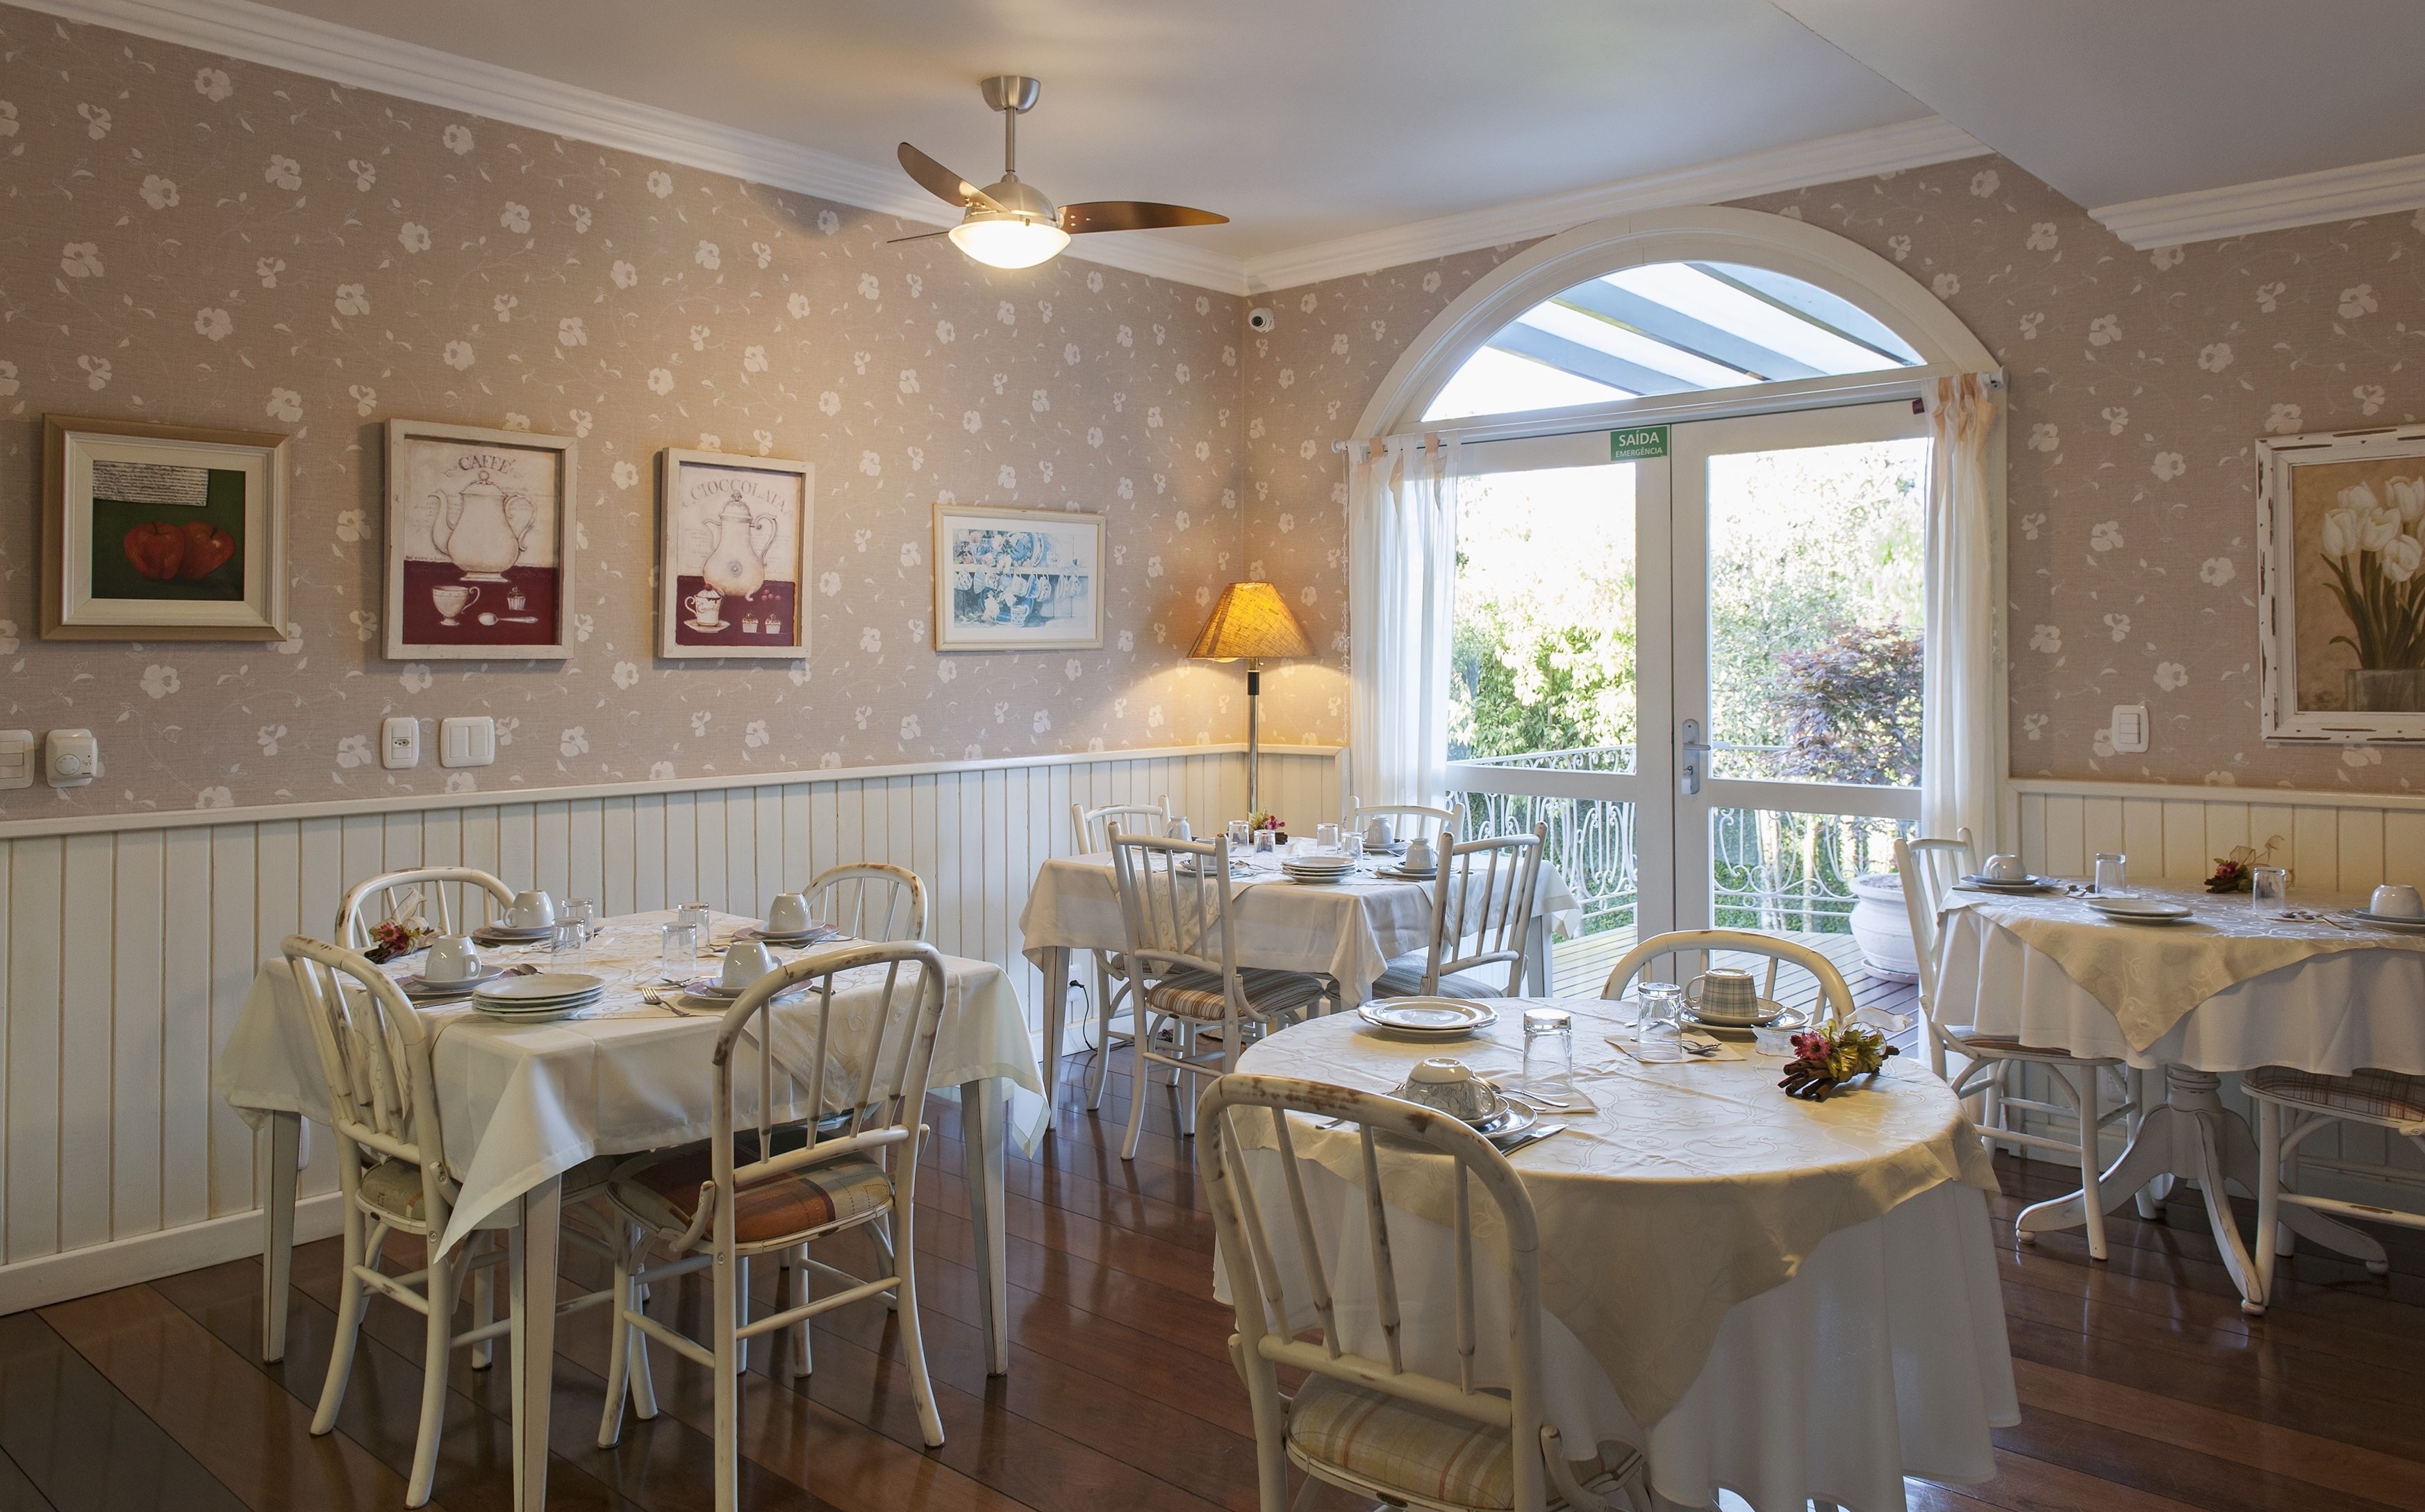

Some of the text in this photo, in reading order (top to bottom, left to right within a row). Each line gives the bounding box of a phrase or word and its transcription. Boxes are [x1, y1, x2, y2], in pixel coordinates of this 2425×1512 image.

[1619, 430, 1660, 447] SAÍDA
[1616, 447, 1663, 458] EMERGÊNCIA
[690, 479, 786, 513] CIOCCOLATA
